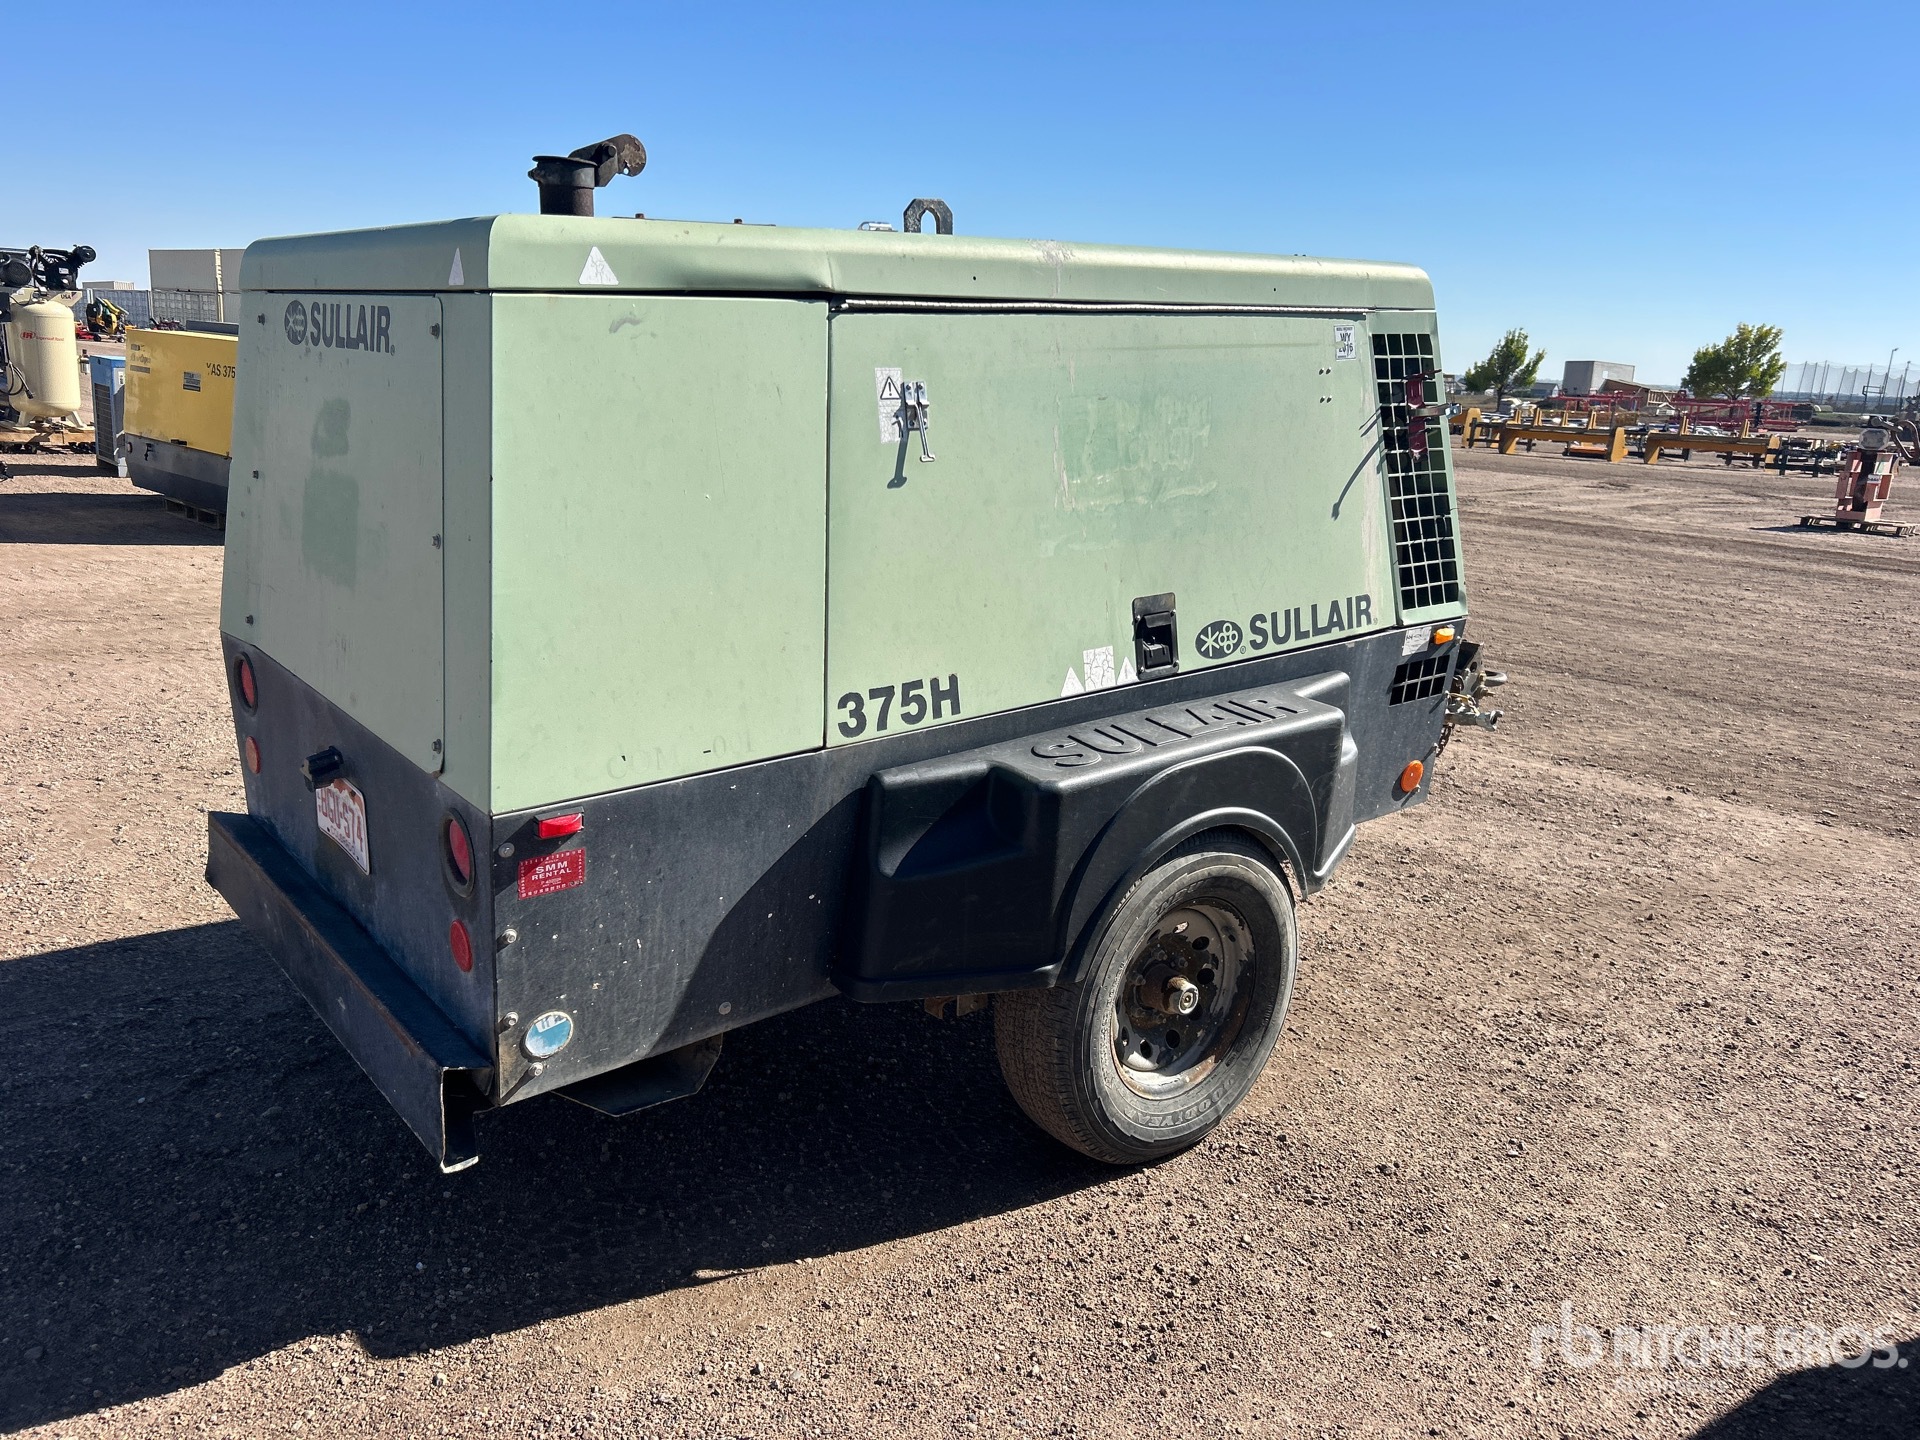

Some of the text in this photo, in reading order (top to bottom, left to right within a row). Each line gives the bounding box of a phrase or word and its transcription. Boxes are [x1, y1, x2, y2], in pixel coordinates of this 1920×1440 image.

[309, 301, 391, 354] SULLAIR
[222, 365, 236, 379] 375
[1249, 593, 1373, 651] SULLAIR
[837, 673, 961, 738] 375H
[1030, 699, 1309, 767] SULLAIR
[531, 867, 572, 881] RENTAL
[535, 861, 568, 874] SMM
